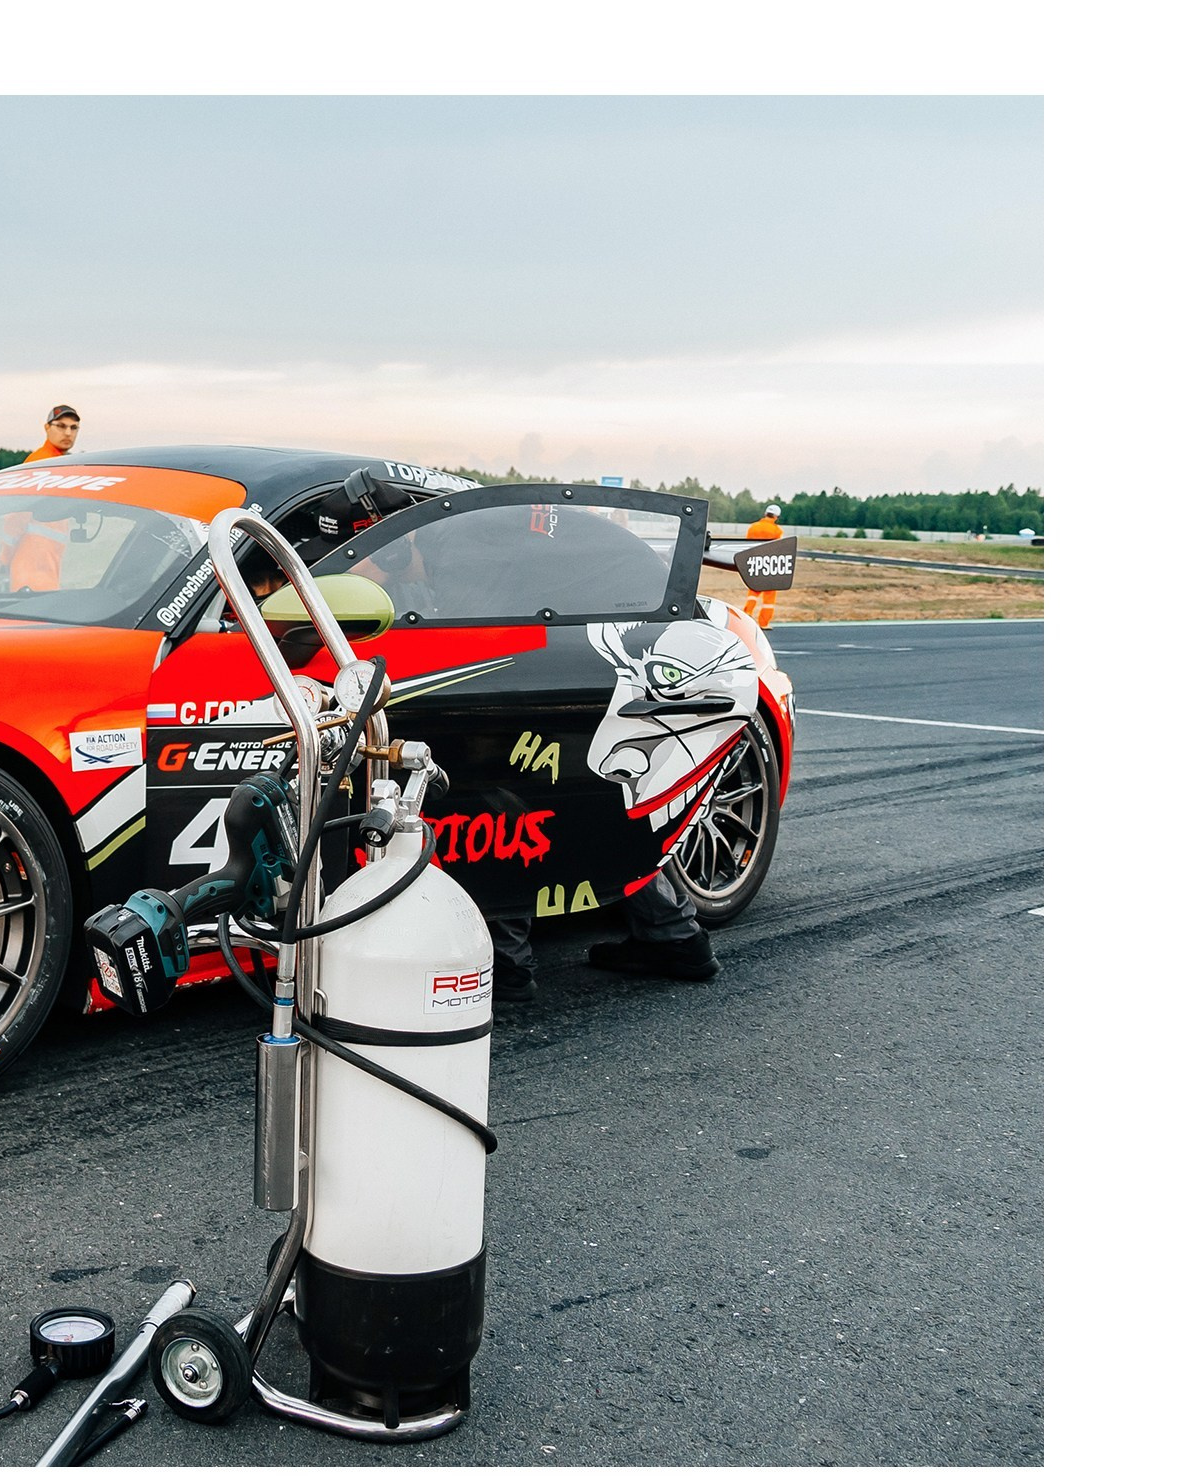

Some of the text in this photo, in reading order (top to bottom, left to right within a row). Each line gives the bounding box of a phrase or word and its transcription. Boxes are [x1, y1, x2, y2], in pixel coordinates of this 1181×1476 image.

[746, 554, 793, 577] #PSCCE
[97, 733, 126, 744] ACTION
[509, 731, 560, 784] HA
